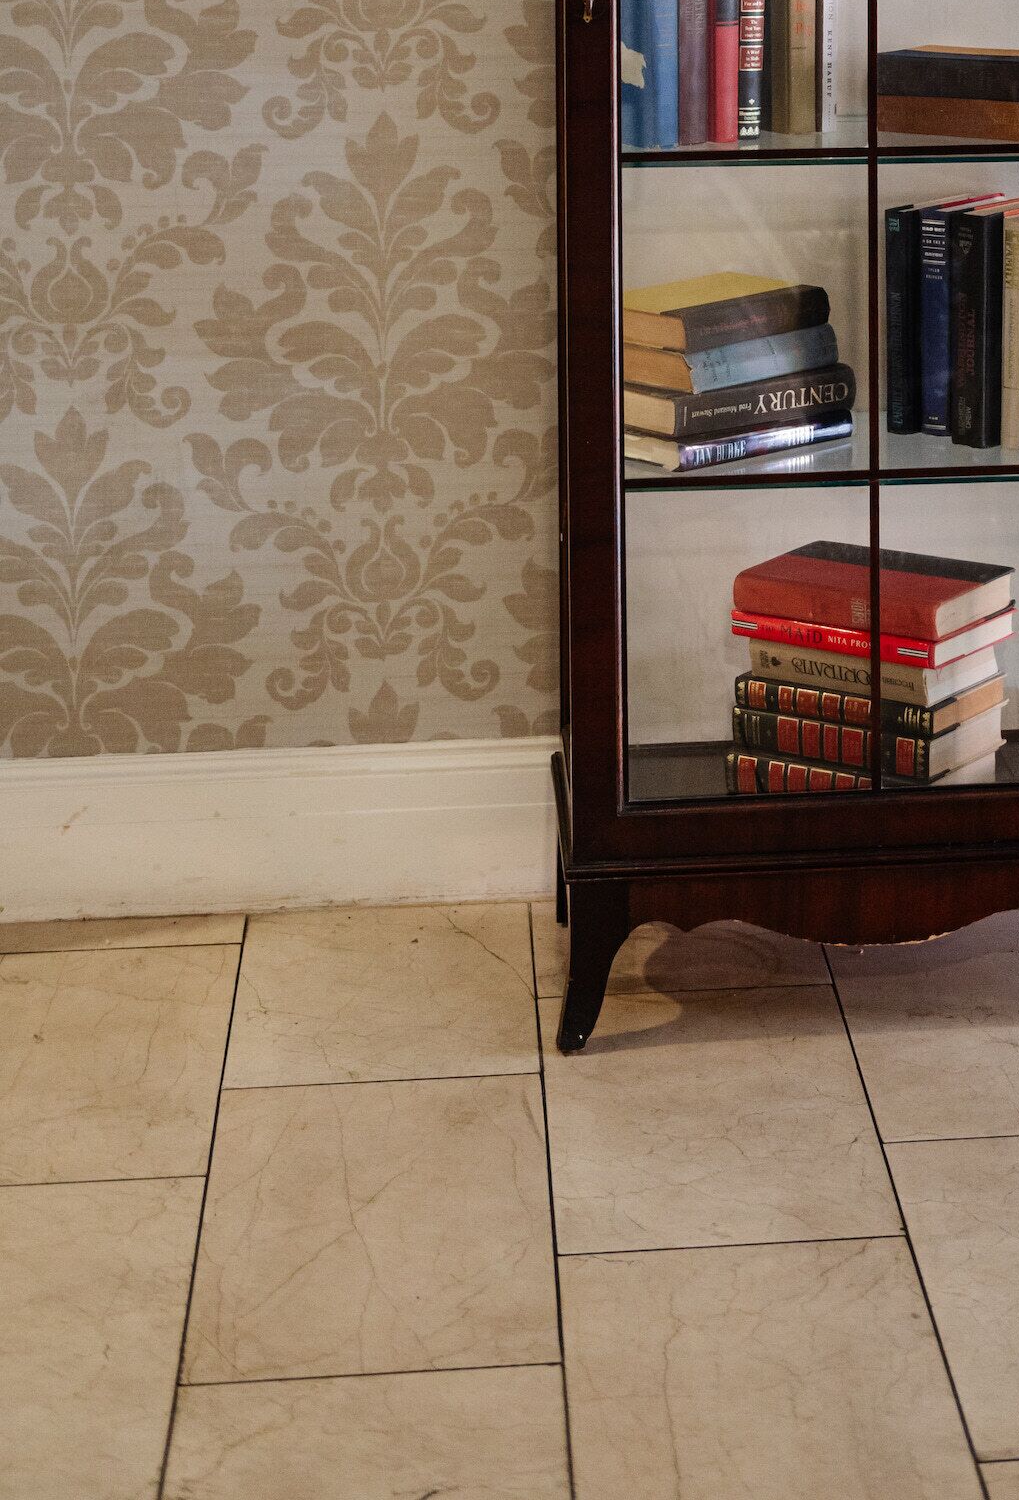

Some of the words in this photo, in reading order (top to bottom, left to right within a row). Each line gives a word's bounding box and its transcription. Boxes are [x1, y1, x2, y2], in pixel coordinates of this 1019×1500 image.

[738, 402, 752, 412] Fred
[754, 382, 849, 415] CENTURY
[691, 409, 713, 419] Stewart
[965, 406, 973, 429] DREW
[694, 445, 712, 465] JAN
[716, 440, 747, 461] BURKE
[827, 635, 848, 646] NITA
